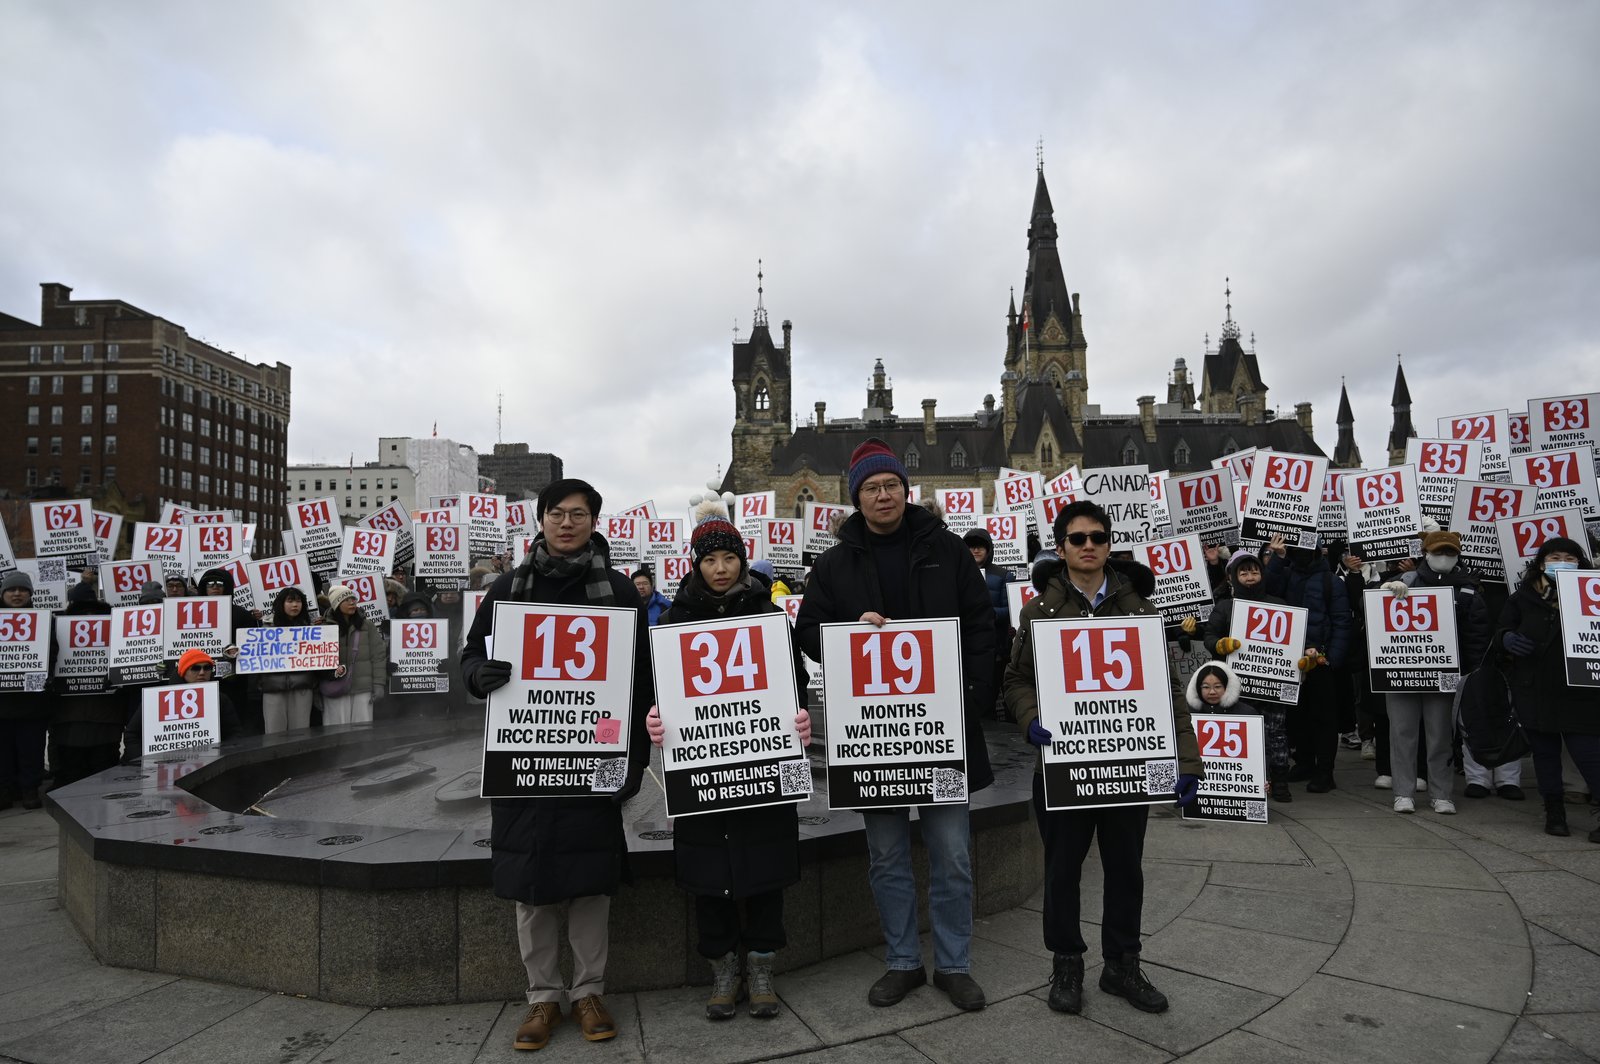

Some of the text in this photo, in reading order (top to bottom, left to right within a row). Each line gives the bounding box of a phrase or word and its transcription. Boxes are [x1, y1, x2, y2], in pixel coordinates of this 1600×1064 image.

[1549, 400, 1584, 430] 33
[1457, 417, 1490, 443] 22
[1550, 432, 1585, 441] MONTHS
[1424, 444, 1462, 473] 35
[1270, 458, 1307, 491] 30
[1533, 454, 1570, 489] 37
[1008, 480, 1031, 504] 38
[1055, 475, 1071, 493] 19
[1084, 474, 1150, 495] CANADA
[1184, 477, 1217, 506] 70
[1363, 474, 1398, 507] 68
[948, 493, 971, 512] 32
[1267, 491, 1302, 502] MONTHS
[1475, 488, 1516, 520] 53
[1538, 489, 1576, 501] MONTHS
[1570, 498, 1588, 507] FOR
[302, 503, 327, 526] 31
[472, 497, 495, 518] 25
[746, 496, 764, 516] 27
[1123, 503, 1148, 521] ARE
[1187, 505, 1218, 517] MONTHS
[1250, 508, 1313, 523] IRCC RESPONSE
[1257, 499, 1310, 513] WAITING FOR
[1364, 507, 1400, 518] MONTHS
[50, 505, 78, 529] 62
[374, 511, 398, 530] 68
[1180, 511, 1227, 526] WAITING FOR
[1194, 518, 1233, 531] RESPONSE
[1357, 515, 1411, 529] WAITING FOR
[306, 527, 329, 535] MONTHS
[611, 520, 631, 538] 34
[652, 523, 672, 542] 34
[772, 523, 791, 544] 42
[990, 517, 1013, 540] 39
[1372, 524, 1417, 536] RESPONSE
[1520, 519, 1561, 555] 28
[56, 543, 92, 552] RESPONSE
[149, 528, 178, 551] 22
[203, 528, 228, 551] 43
[302, 534, 325, 543] WAITING
[357, 533, 382, 556] 39
[430, 528, 456, 550] 39
[1152, 542, 1187, 574] 30
[118, 565, 147, 592] 39
[266, 561, 296, 587] 40
[668, 559, 689, 579] 30
[1157, 575, 1190, 586] MONTHS
[347, 578, 373, 604] 39
[1166, 590, 1207, 602] RESPONSE
[128, 610, 156, 636] 19
[183, 602, 211, 629] 11
[1390, 597, 1431, 631] 65
[0, 614, 31, 640] 53
[74, 621, 105, 646] 81
[246, 627, 321, 642] STOP THE
[1250, 609, 1287, 643] 20
[126, 638, 156, 647] MONTHS
[173, 640, 204, 648] WAITING
[406, 624, 433, 648] 39
[1391, 635, 1433, 643] MONTHS
[534, 615, 596, 679] 13
[1248, 645, 1283, 656] MONTHS
[1381, 645, 1445, 654] WAITING FOR
[1573, 644, 1599, 654] IRCC
[690, 627, 758, 694] 34
[862, 632, 922, 694] 19
[1072, 629, 1133, 691] 15
[1238, 653, 1291, 668] WAITING FOR
[1376, 656, 1452, 664] IRCC RESPONSE
[1232, 662, 1295, 678] IRCC RESPONSE
[165, 689, 198, 720] 18
[528, 690, 595, 705] MONTHS
[1074, 699, 1137, 715] MONTHS
[509, 709, 576, 724] WAITING
[694, 699, 761, 720] MONTHS
[861, 703, 926, 720] MONTHS
[164, 722, 199, 732] MONTHS
[680, 717, 780, 742] WAITING FOR
[845, 721, 944, 739] WAITING FOR
[1060, 717, 1155, 735] WAITING FOR
[154, 730, 209, 742] WAITING FOR
[497, 729, 533, 743] IRCC
[1052, 736, 1166, 755] IRCC RESPONSE
[1202, 721, 1242, 757] 25
[149, 744, 168, 752] IRCC
[672, 735, 792, 762] IRCC RESPONSE
[836, 739, 955, 758] IRCC RESPONSE
[512, 758, 530, 770] NO
[516, 773, 593, 787] NO RESULTS
[691, 764, 779, 786] NO TIMELINES
[854, 770, 871, 782] NO
[1070, 768, 1087, 780] NO
[1235, 774, 1253, 783] FOR
[698, 781, 775, 802] NO RESULTS
[860, 785, 877, 797] NO
[1076, 784, 1093, 796] NO
[1210, 783, 1260, 794] RESPONSE
